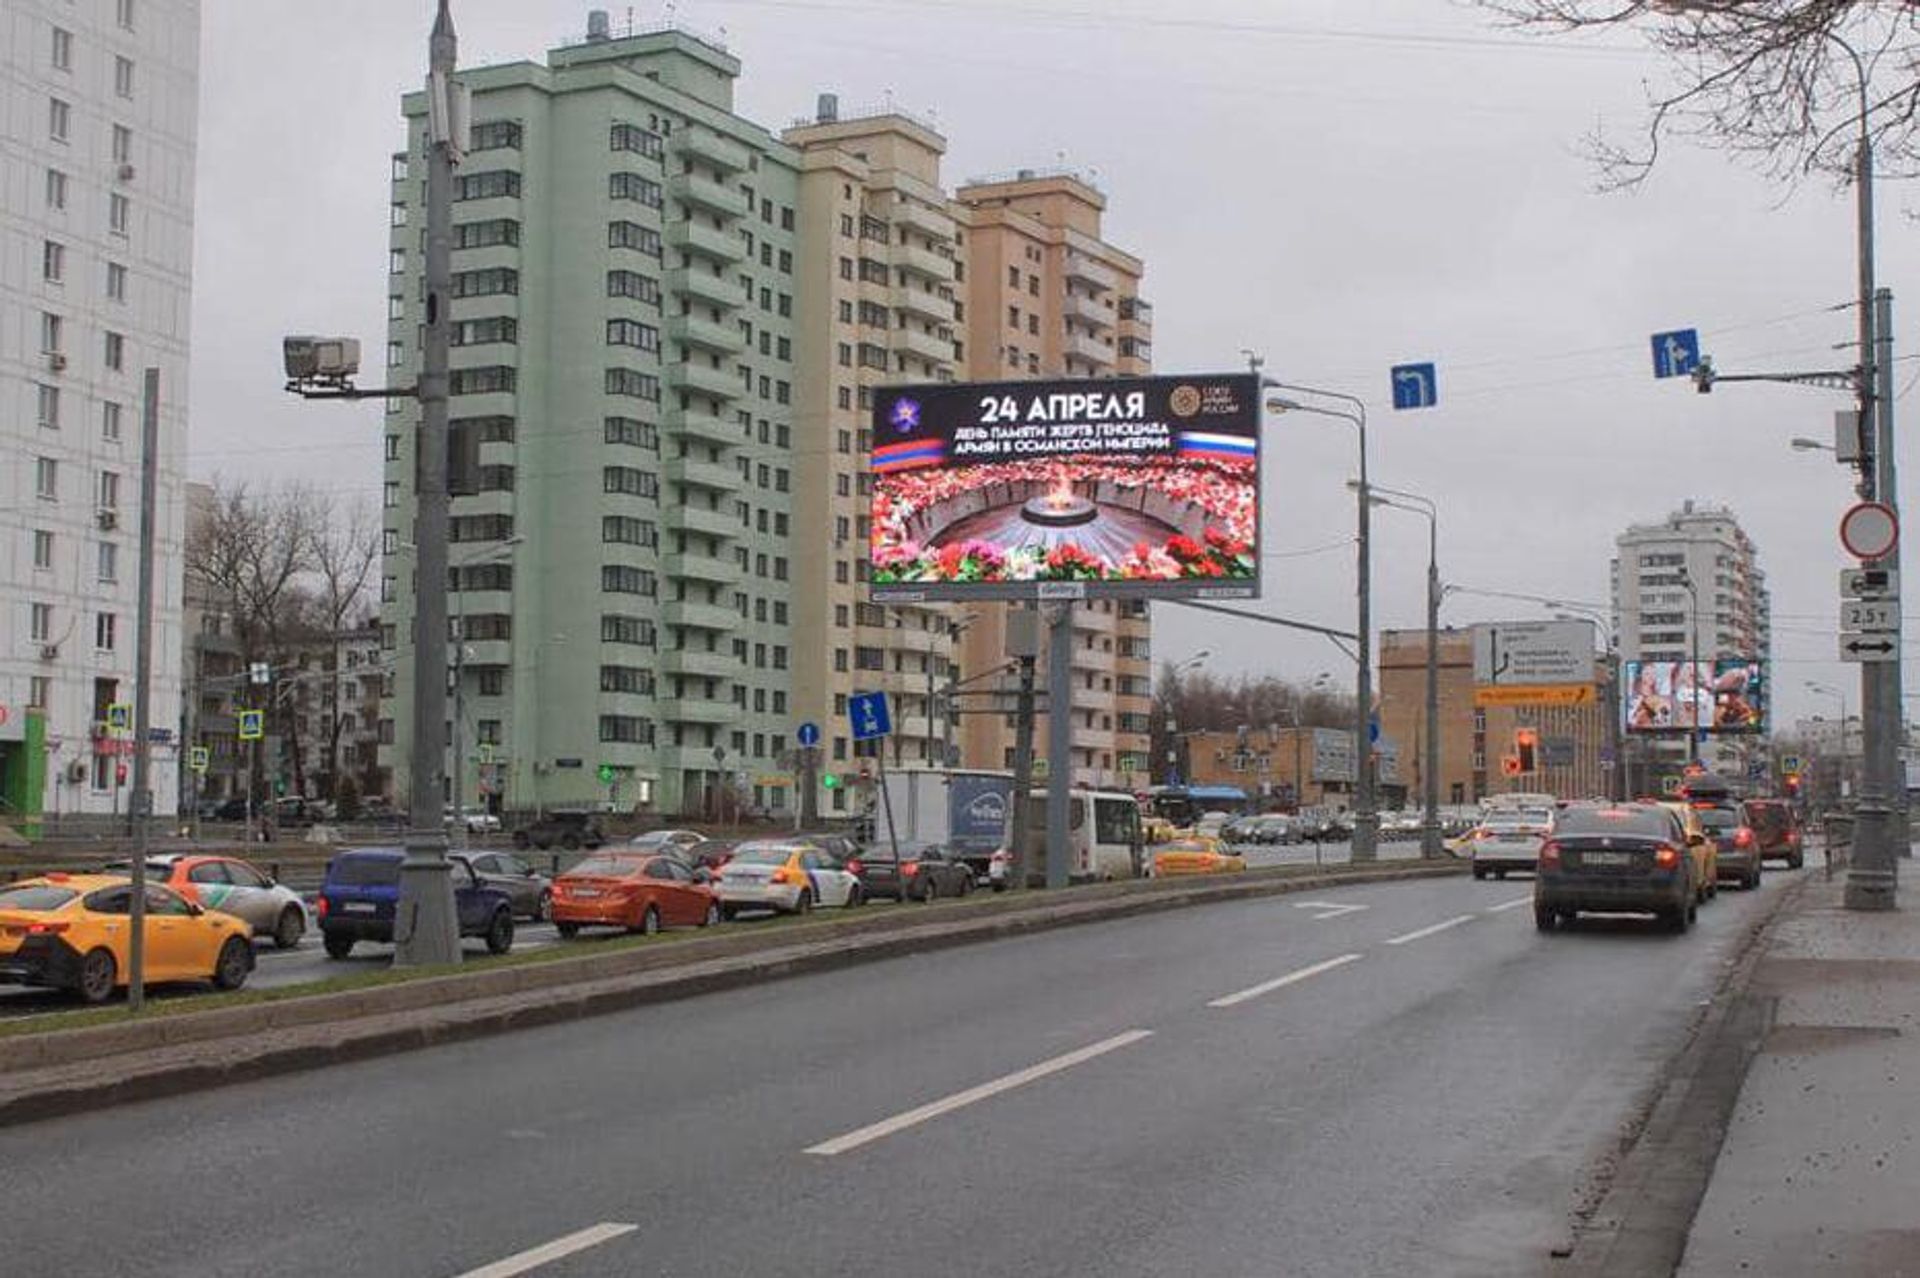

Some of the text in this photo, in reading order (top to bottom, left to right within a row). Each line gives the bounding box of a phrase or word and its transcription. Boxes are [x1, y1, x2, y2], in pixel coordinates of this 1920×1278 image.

[980, 391, 1144, 422] 24 АПРЕЛЯ
[954, 421, 1169, 440] ДЕНЬ ПАМЯТИ ЖЕРТВ ГЕНОЦИДА
[955, 439, 1000, 453] АРМЯН
[1003, 439, 1012, 452] В
